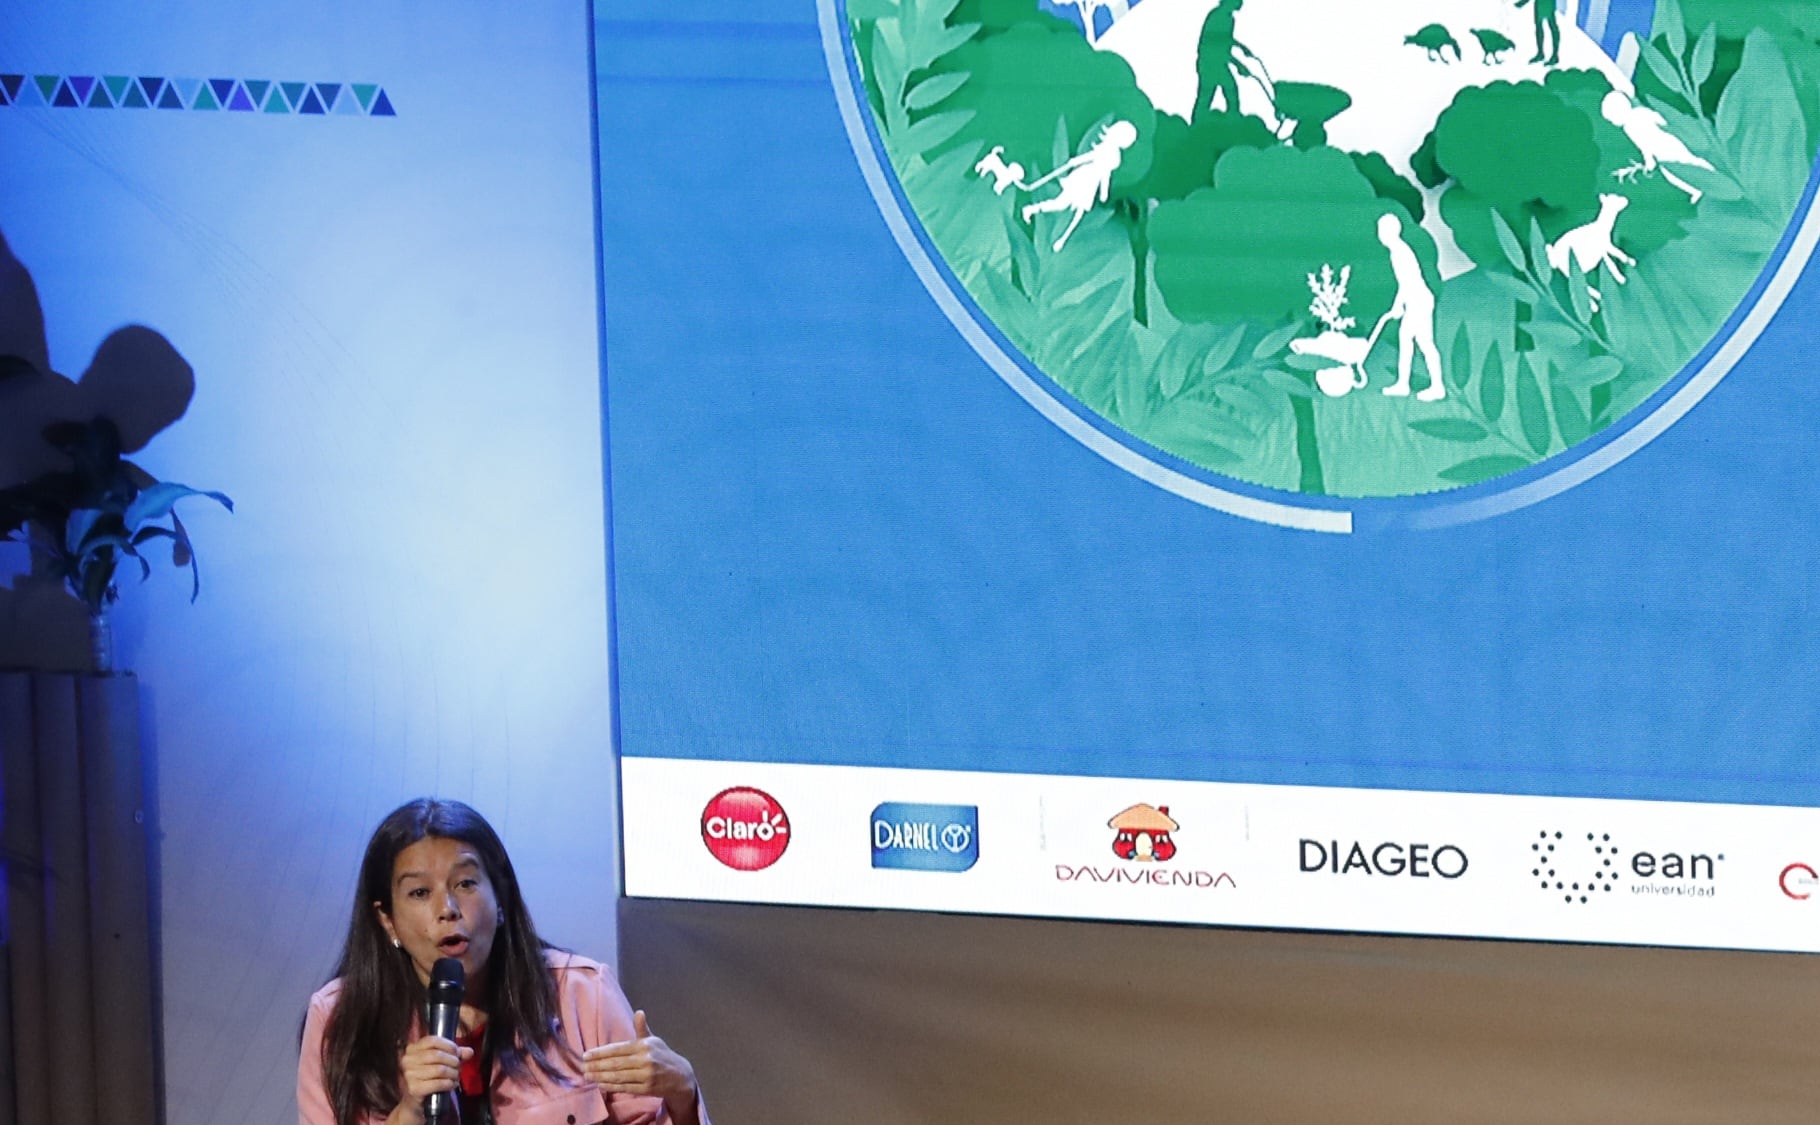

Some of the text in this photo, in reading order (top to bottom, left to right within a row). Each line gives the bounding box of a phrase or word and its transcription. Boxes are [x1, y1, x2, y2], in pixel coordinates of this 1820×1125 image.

[706, 811, 775, 841] Claro
[874, 820, 938, 852] DARNEL
[1299, 838, 1469, 879] DIAGEO
[1631, 851, 1714, 880] ean
[1055, 864, 1237, 889] DAVIVIENDA
[1631, 882, 1716, 898] universidad
